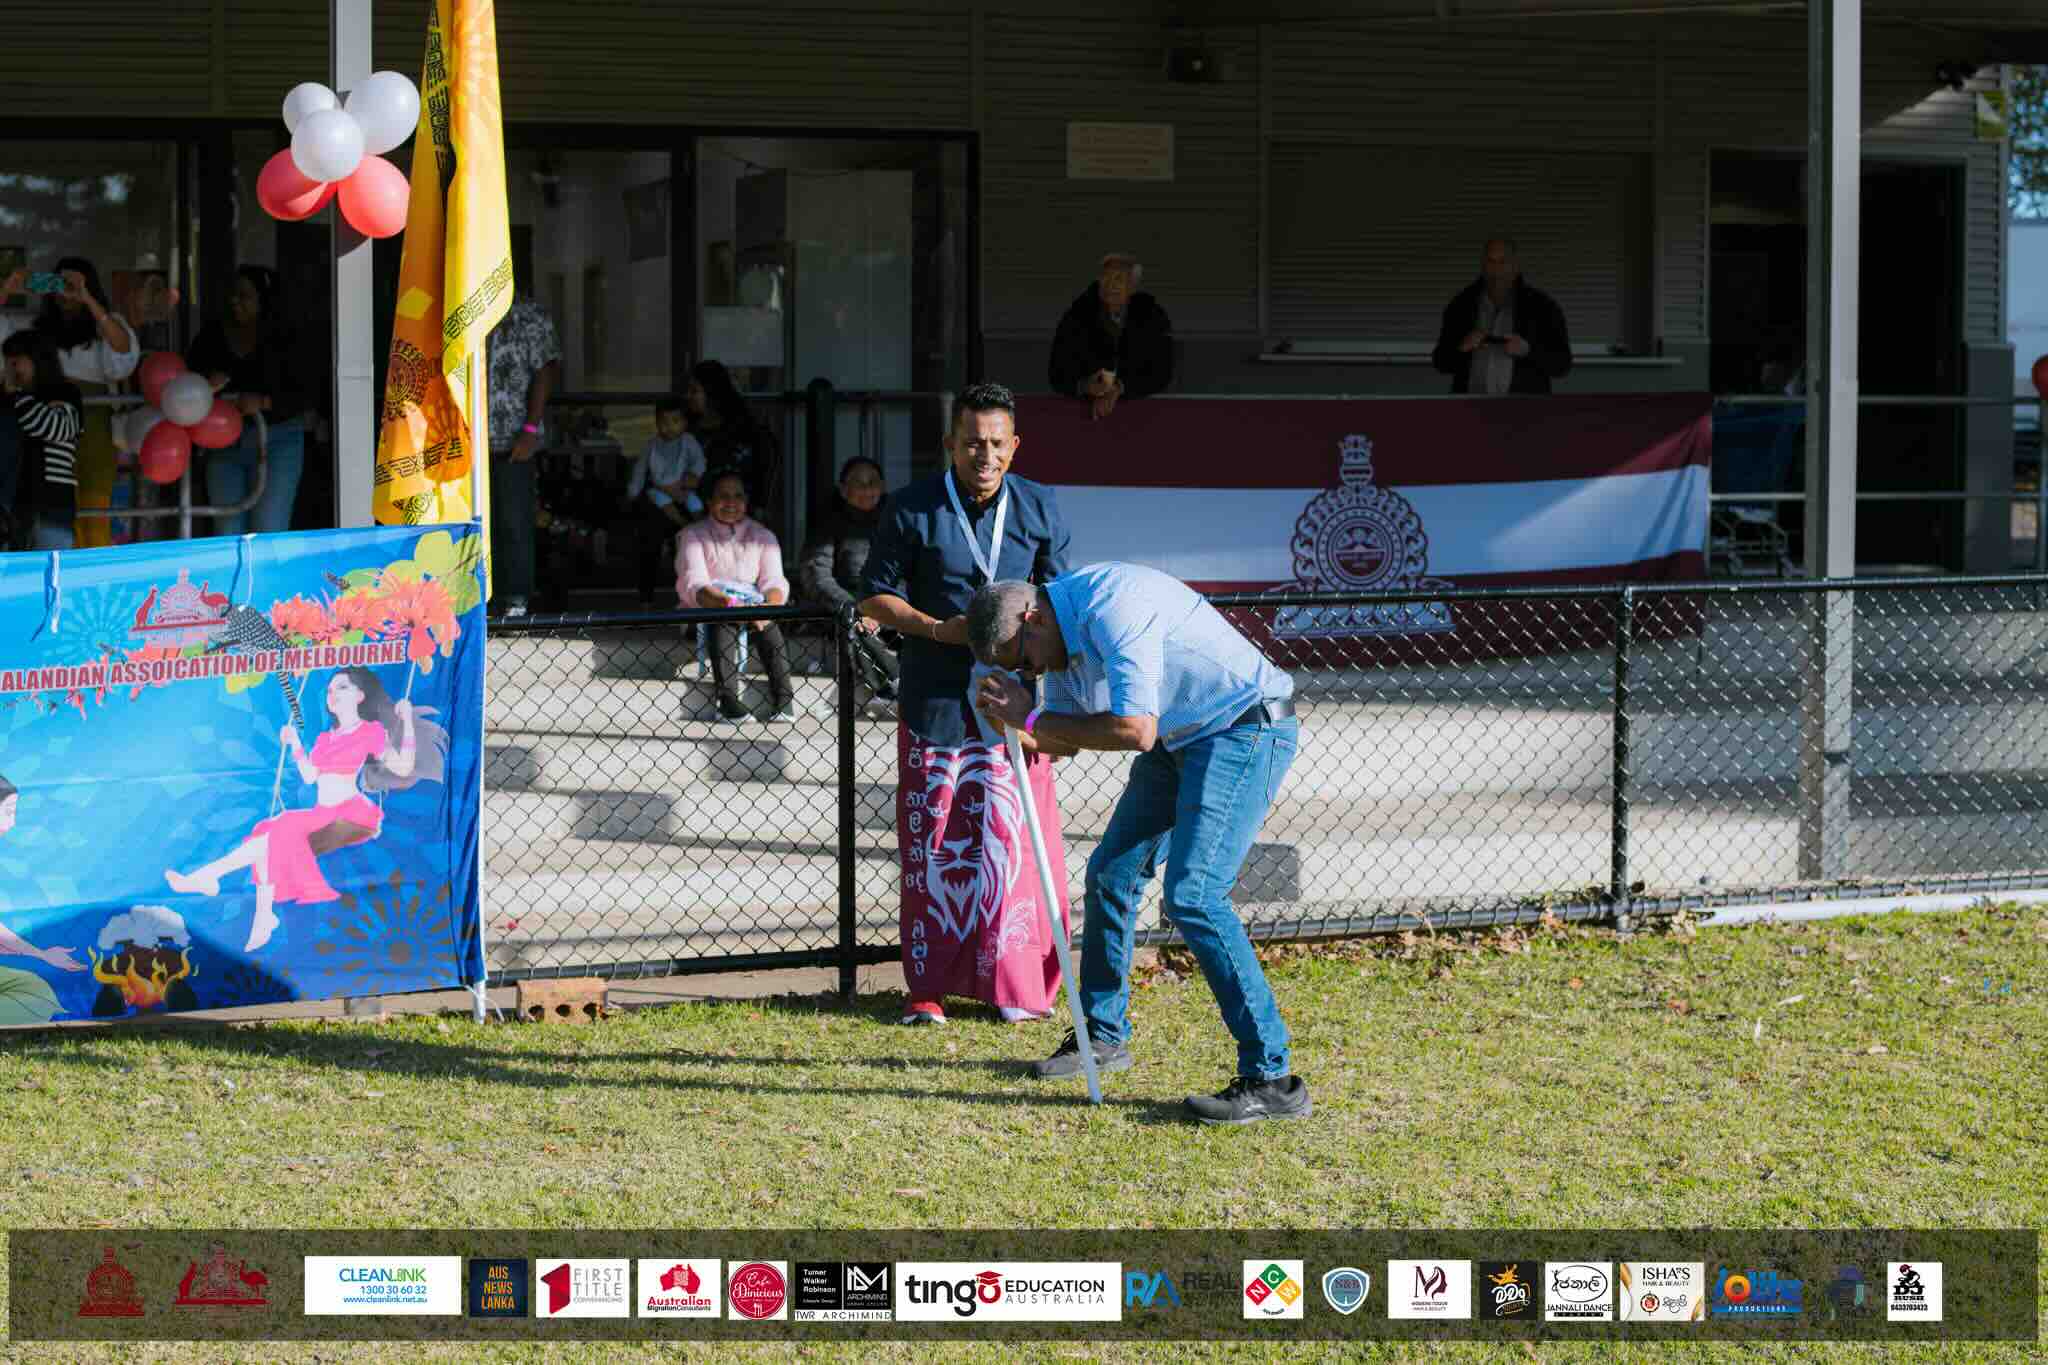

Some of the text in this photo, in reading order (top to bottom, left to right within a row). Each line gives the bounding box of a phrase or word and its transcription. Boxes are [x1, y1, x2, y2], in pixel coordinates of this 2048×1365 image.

[110, 653, 249, 684] ASSOICATION
[254, 651, 280, 672] OF
[283, 640, 406, 669] MELBOURNE
